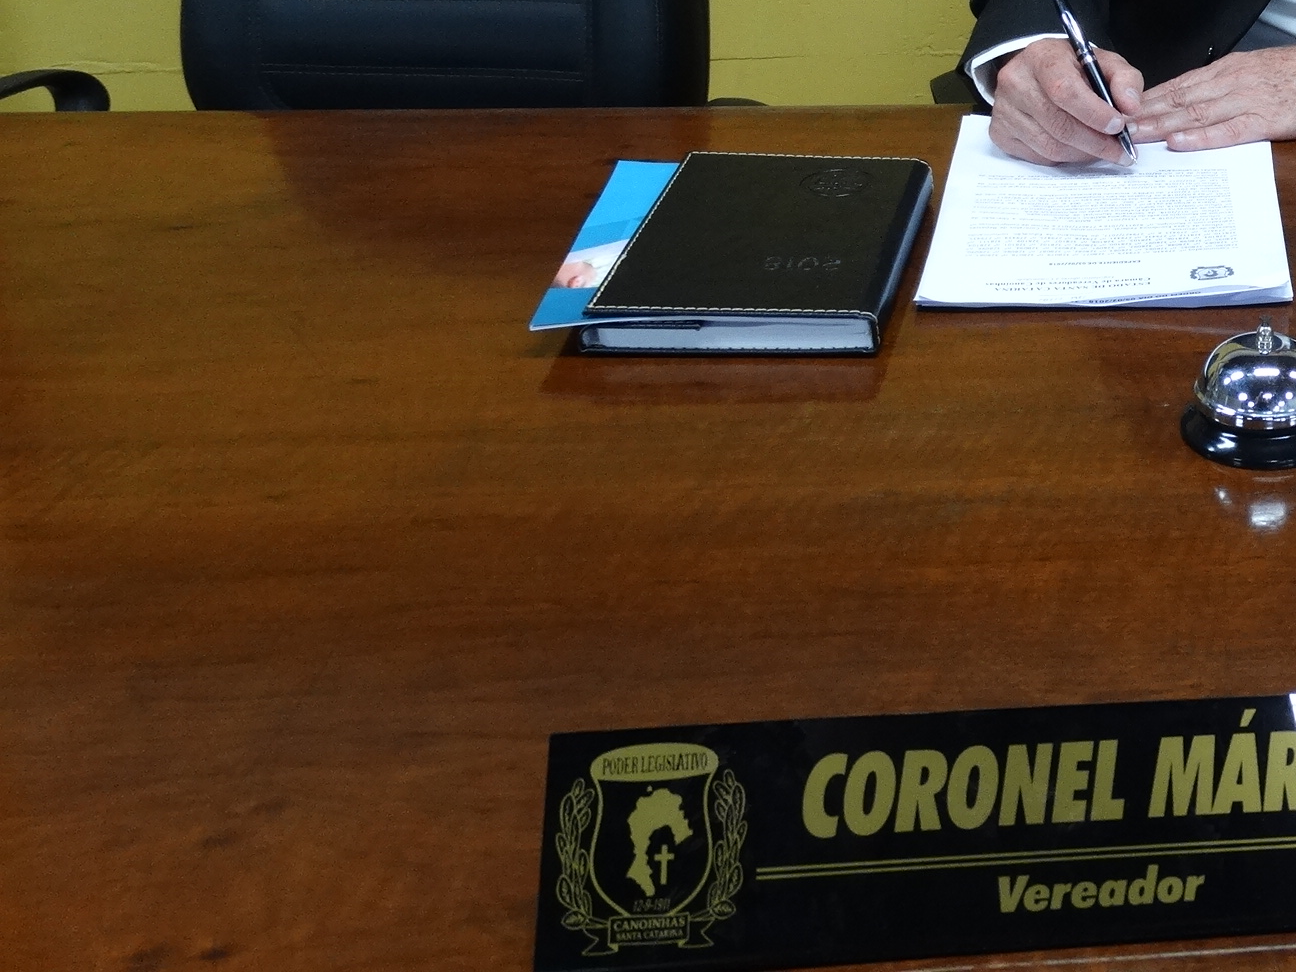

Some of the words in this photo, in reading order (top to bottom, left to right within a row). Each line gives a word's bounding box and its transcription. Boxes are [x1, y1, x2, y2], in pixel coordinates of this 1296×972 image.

[602, 756, 641, 776] PODER
[640, 752, 709, 774] LEGISLATIVO
[801, 738, 1125, 839] CORONEL
[998, 864, 1205, 914] Vereador
[613, 916, 686, 932] CANOINHAS
[616, 930, 643, 941] SANTA
